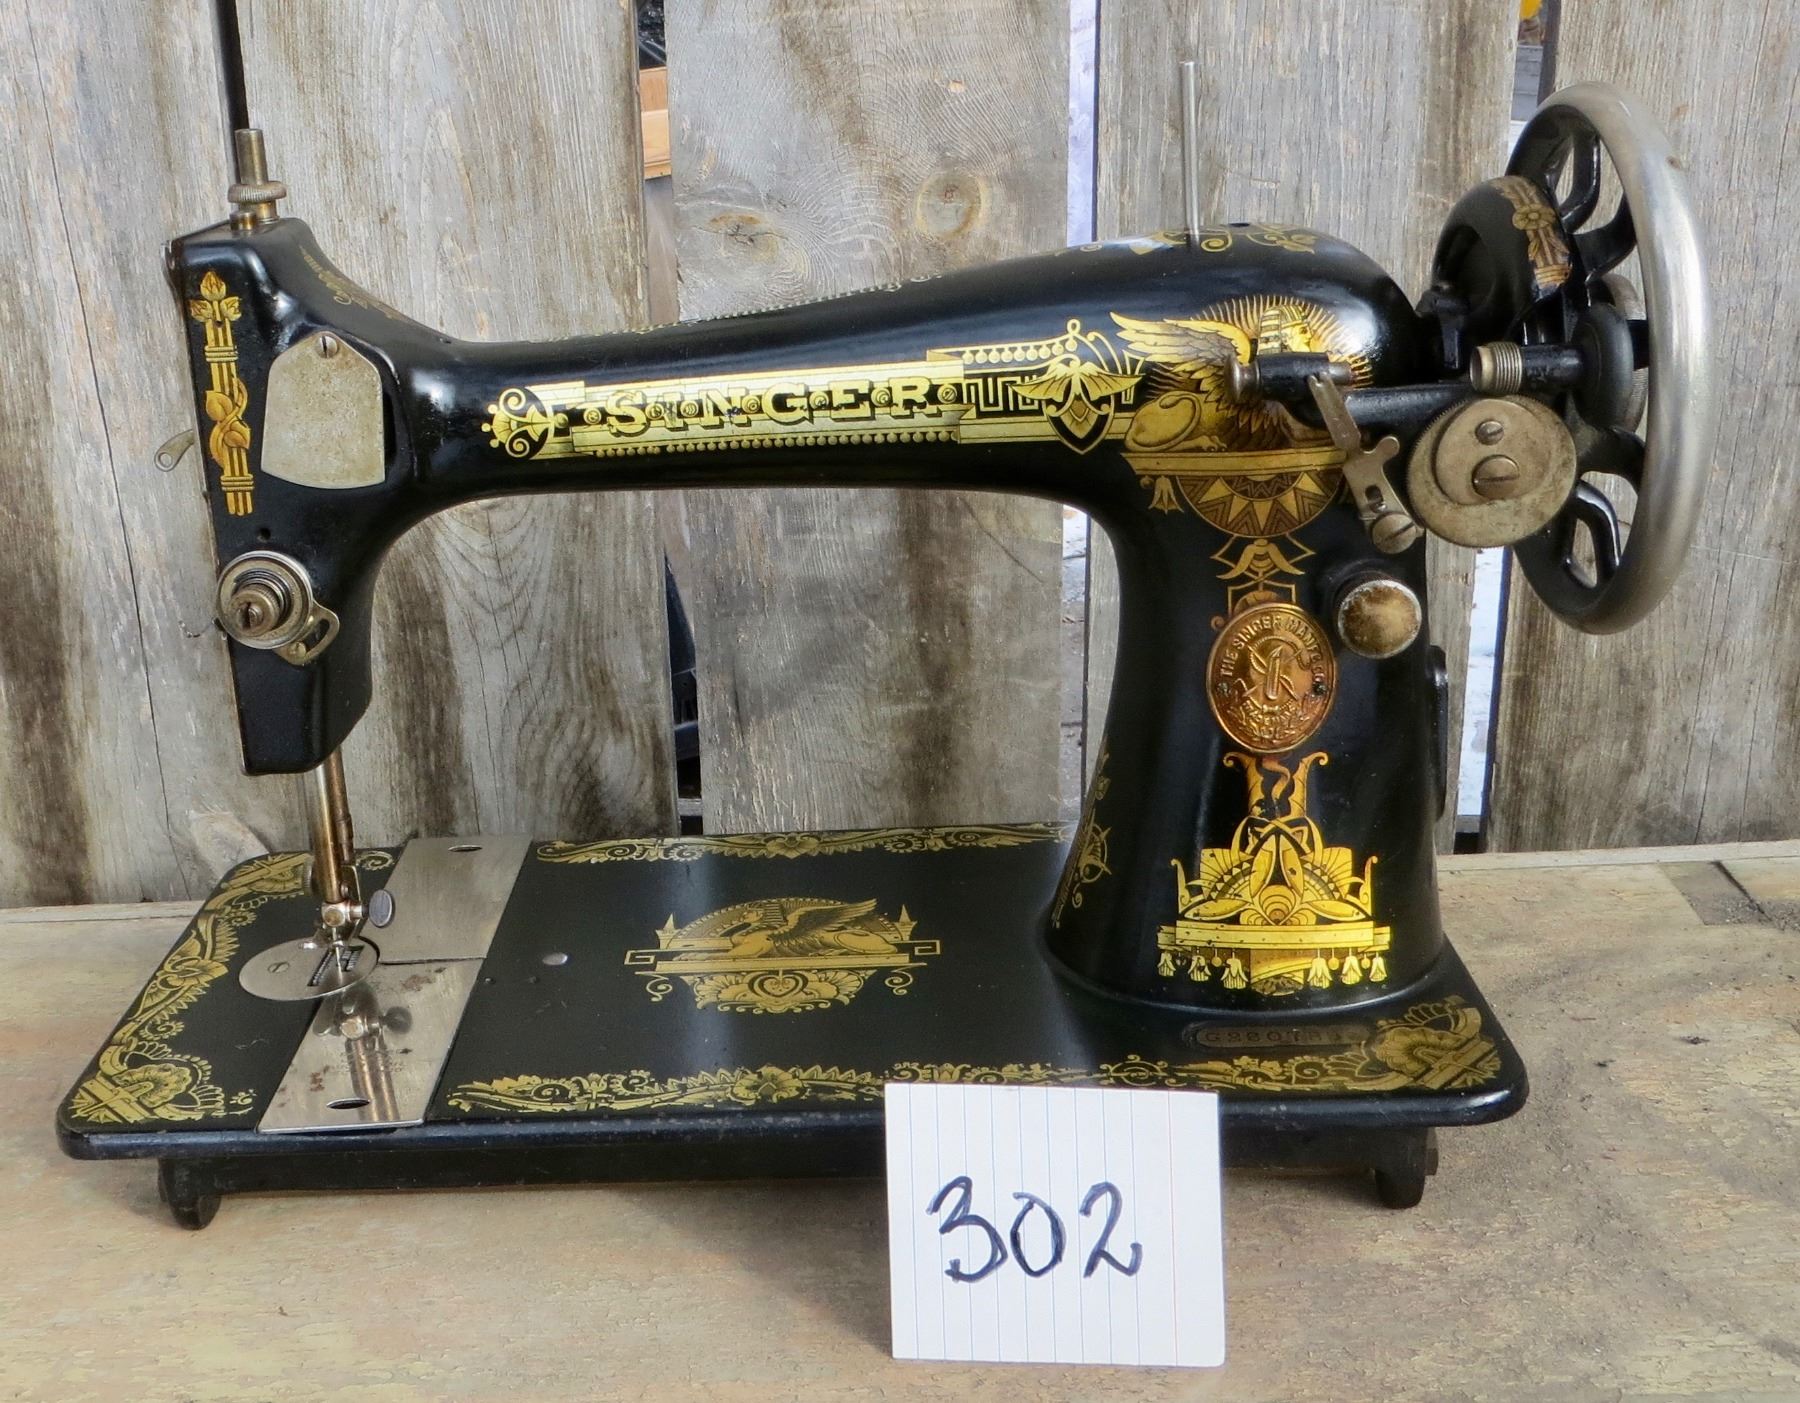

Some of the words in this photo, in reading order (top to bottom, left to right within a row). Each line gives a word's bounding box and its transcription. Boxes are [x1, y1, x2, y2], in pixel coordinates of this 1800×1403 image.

[606, 376, 935, 438] SINGER
[1219, 648, 1239, 678] THE
[1231, 615, 1282, 650] SINGER
[925, 1175, 1143, 1283] 302
